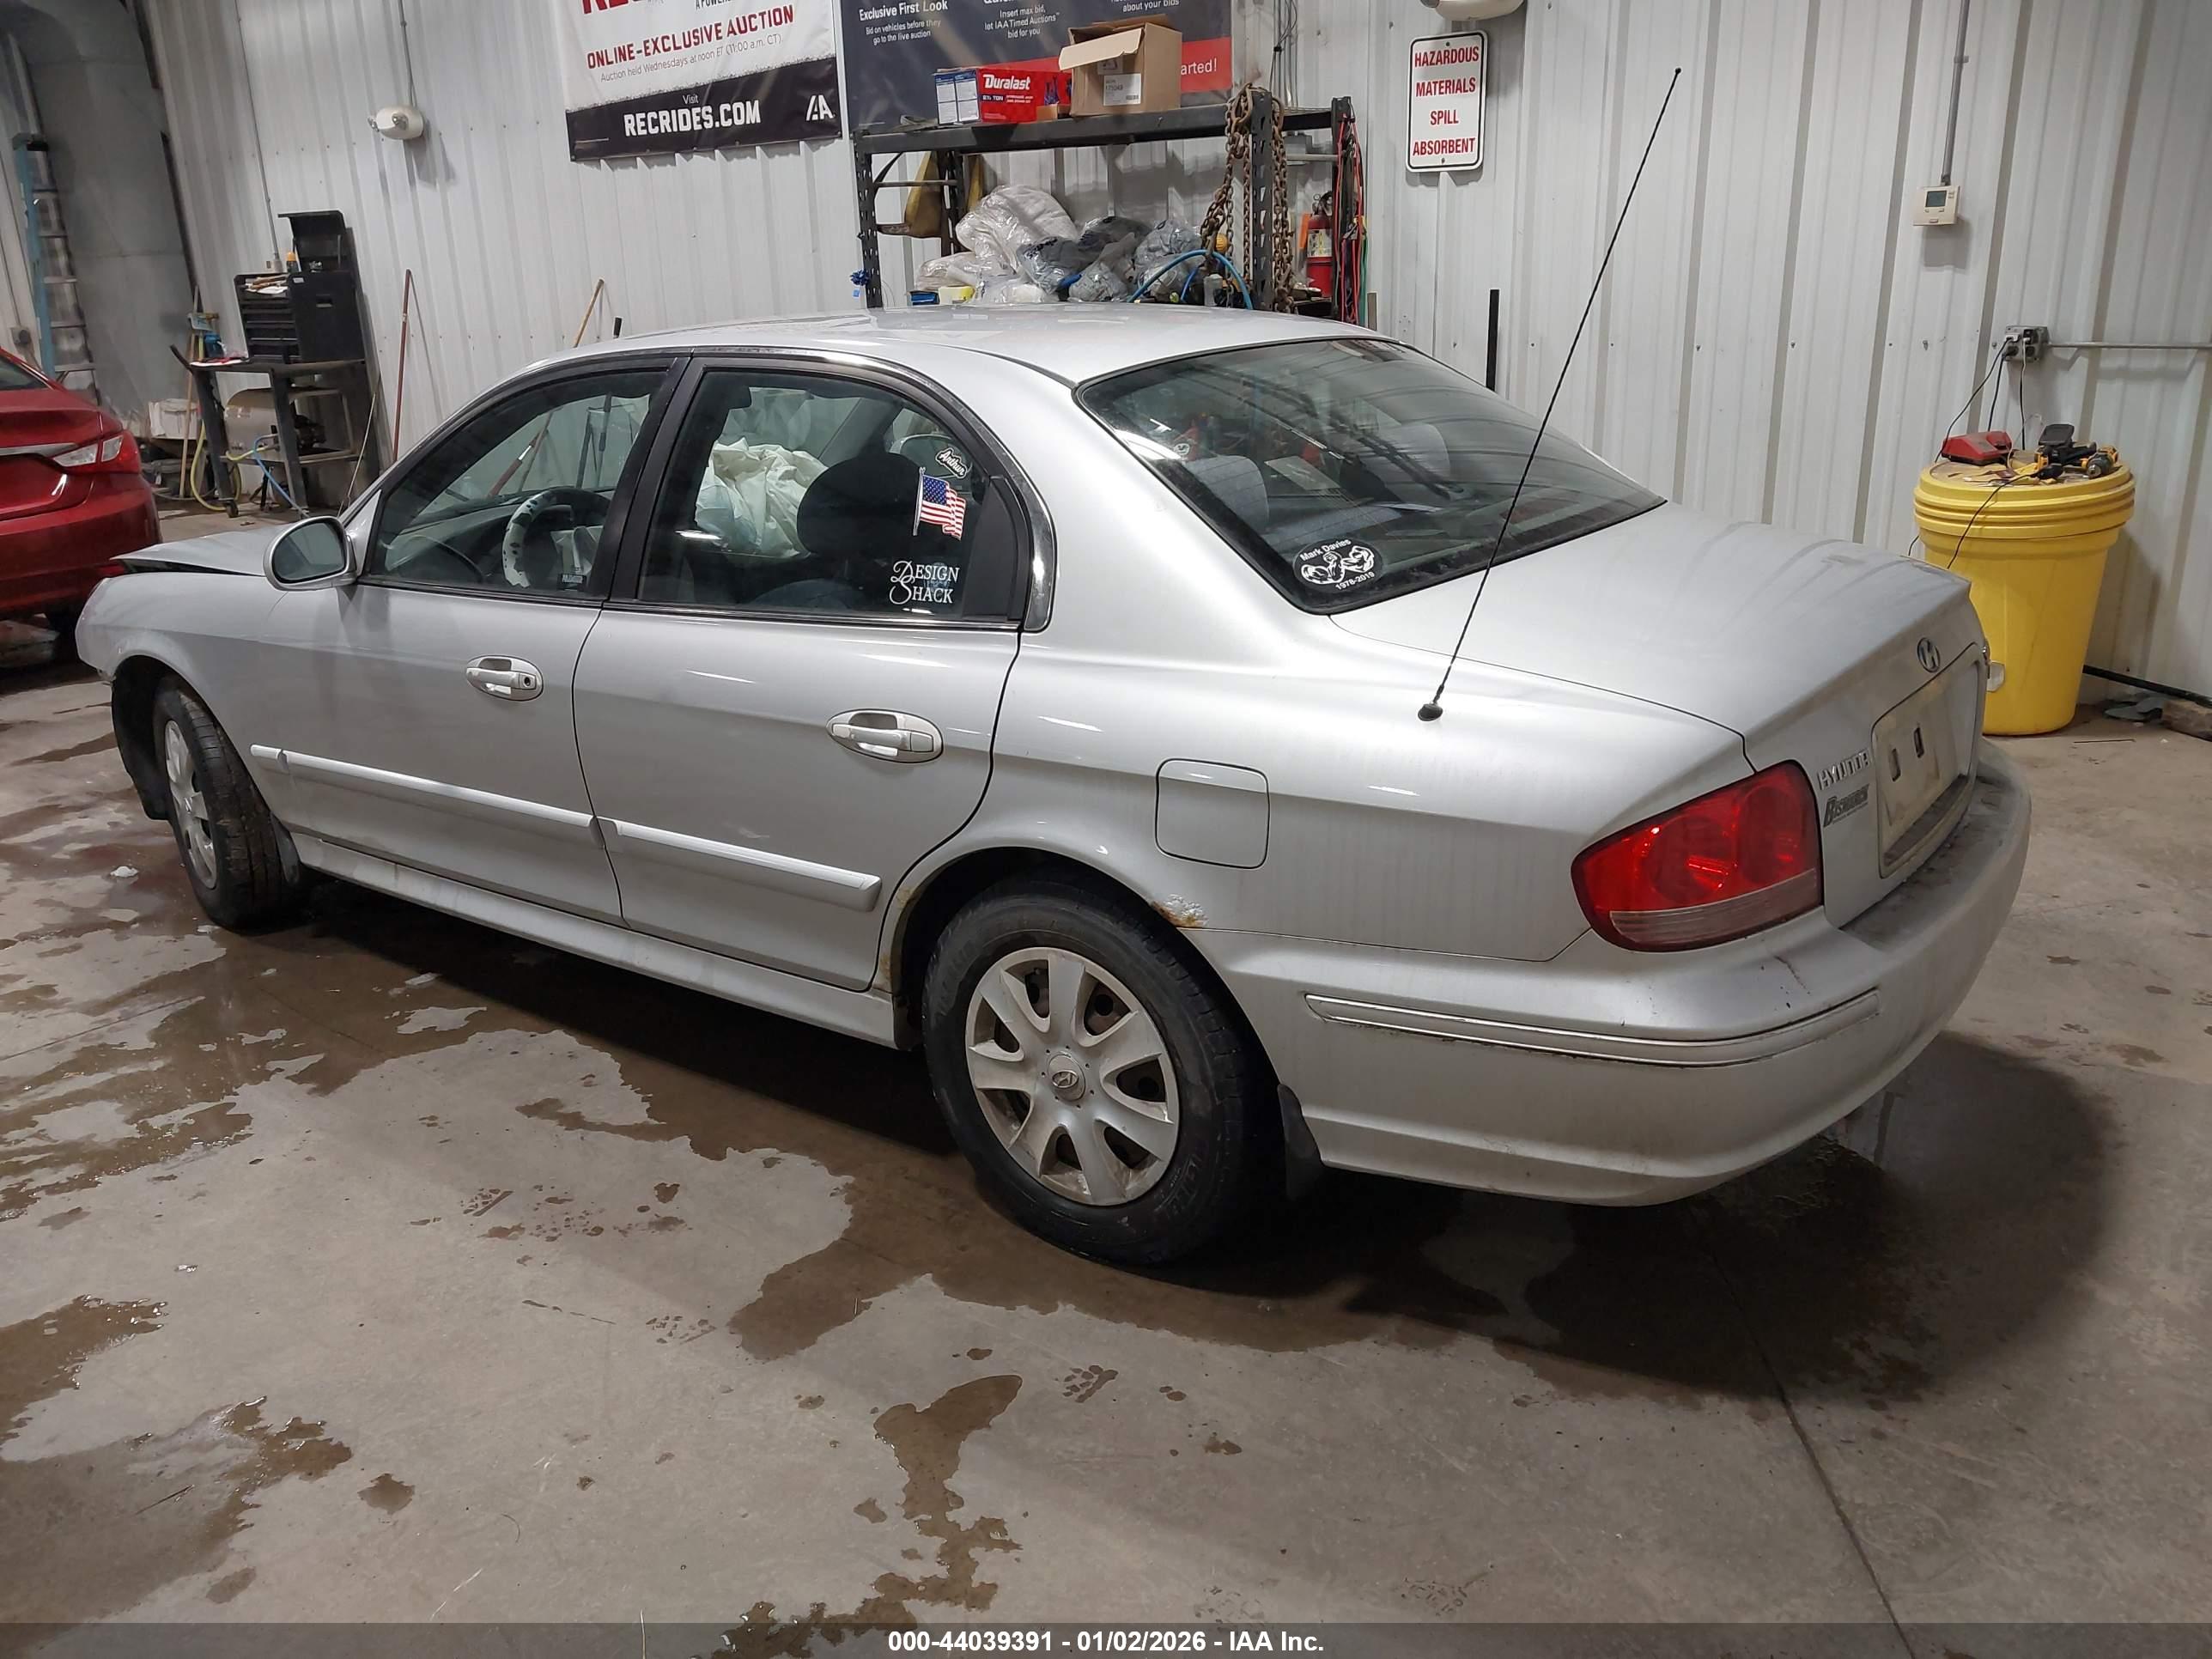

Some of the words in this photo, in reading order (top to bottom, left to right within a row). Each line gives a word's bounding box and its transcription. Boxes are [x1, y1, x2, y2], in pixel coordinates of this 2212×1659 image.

[859, 5, 897, 21] Exclusive
[899, 3, 920, 15] First
[923, 0, 948, 11] Look
[1000, 9, 1018, 18] Insert
[1122, 3, 1143, 13] about
[1144, 0, 1161, 11] your
[882, 22, 906, 33] vehicles
[907, 20, 925, 29] before
[927, 19, 941, 27] they
[1007, 29, 1018, 39] bid
[1019, 28, 1028, 37] for
[1030, 27, 1041, 37] you
[587, 21, 723, 70] ONLINE-EXCLUSIVE
[726, 4, 794, 37] AUCTION
[873, 37, 880, 46] go
[898, 31, 909, 40] live
[910, 29, 931, 40] auction
[1414, 46, 1480, 68] HAZARDOUS
[601, 70, 626, 82] Auction
[628, 67, 641, 76] held
[643, 57, 688, 73] Wednesdays
[698, 51, 715, 61] noon
[1181, 58, 1218, 76] arted!
[982, 74, 1031, 90] Duralast
[1416, 76, 1476, 97] MATERIALS
[683, 94, 699, 105] Visit
[623, 100, 761, 137] RECRIDES.COM
[1430, 109, 1459, 125] SPILL
[1413, 137, 1475, 156] ABSORBENT
[1299, 548, 1323, 561] Mark
[1321, 538, 1352, 553] Davies
